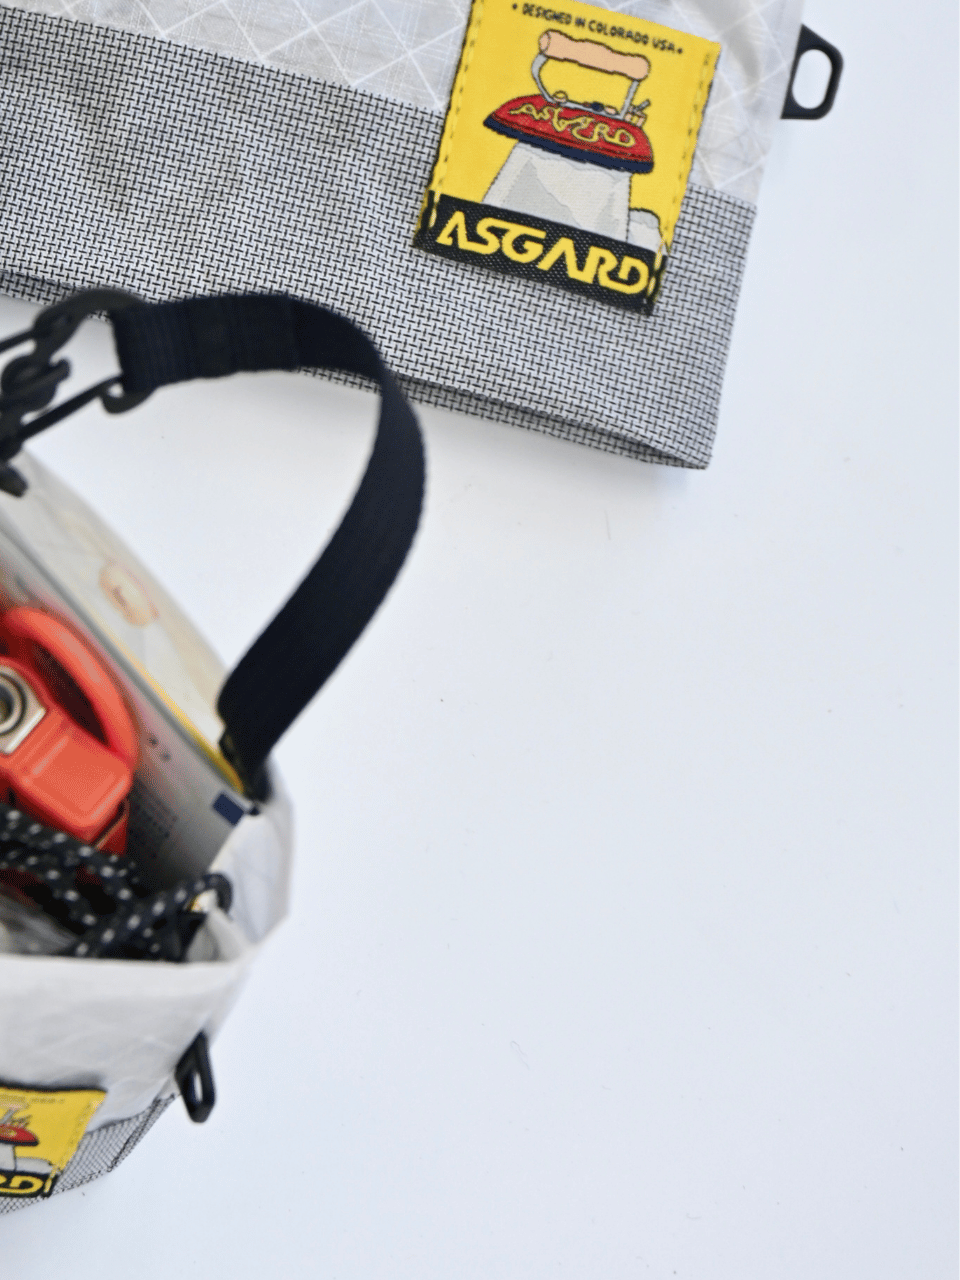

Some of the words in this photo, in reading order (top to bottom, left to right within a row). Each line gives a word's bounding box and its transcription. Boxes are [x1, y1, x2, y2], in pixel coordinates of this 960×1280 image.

[522, 2, 573, 26] DESIGNED
[574, 16, 587, 28] IN
[588, 19, 649, 46] COLORADO
[652, 37, 677, 53] USA
[436, 210, 650, 296] ASGARD
